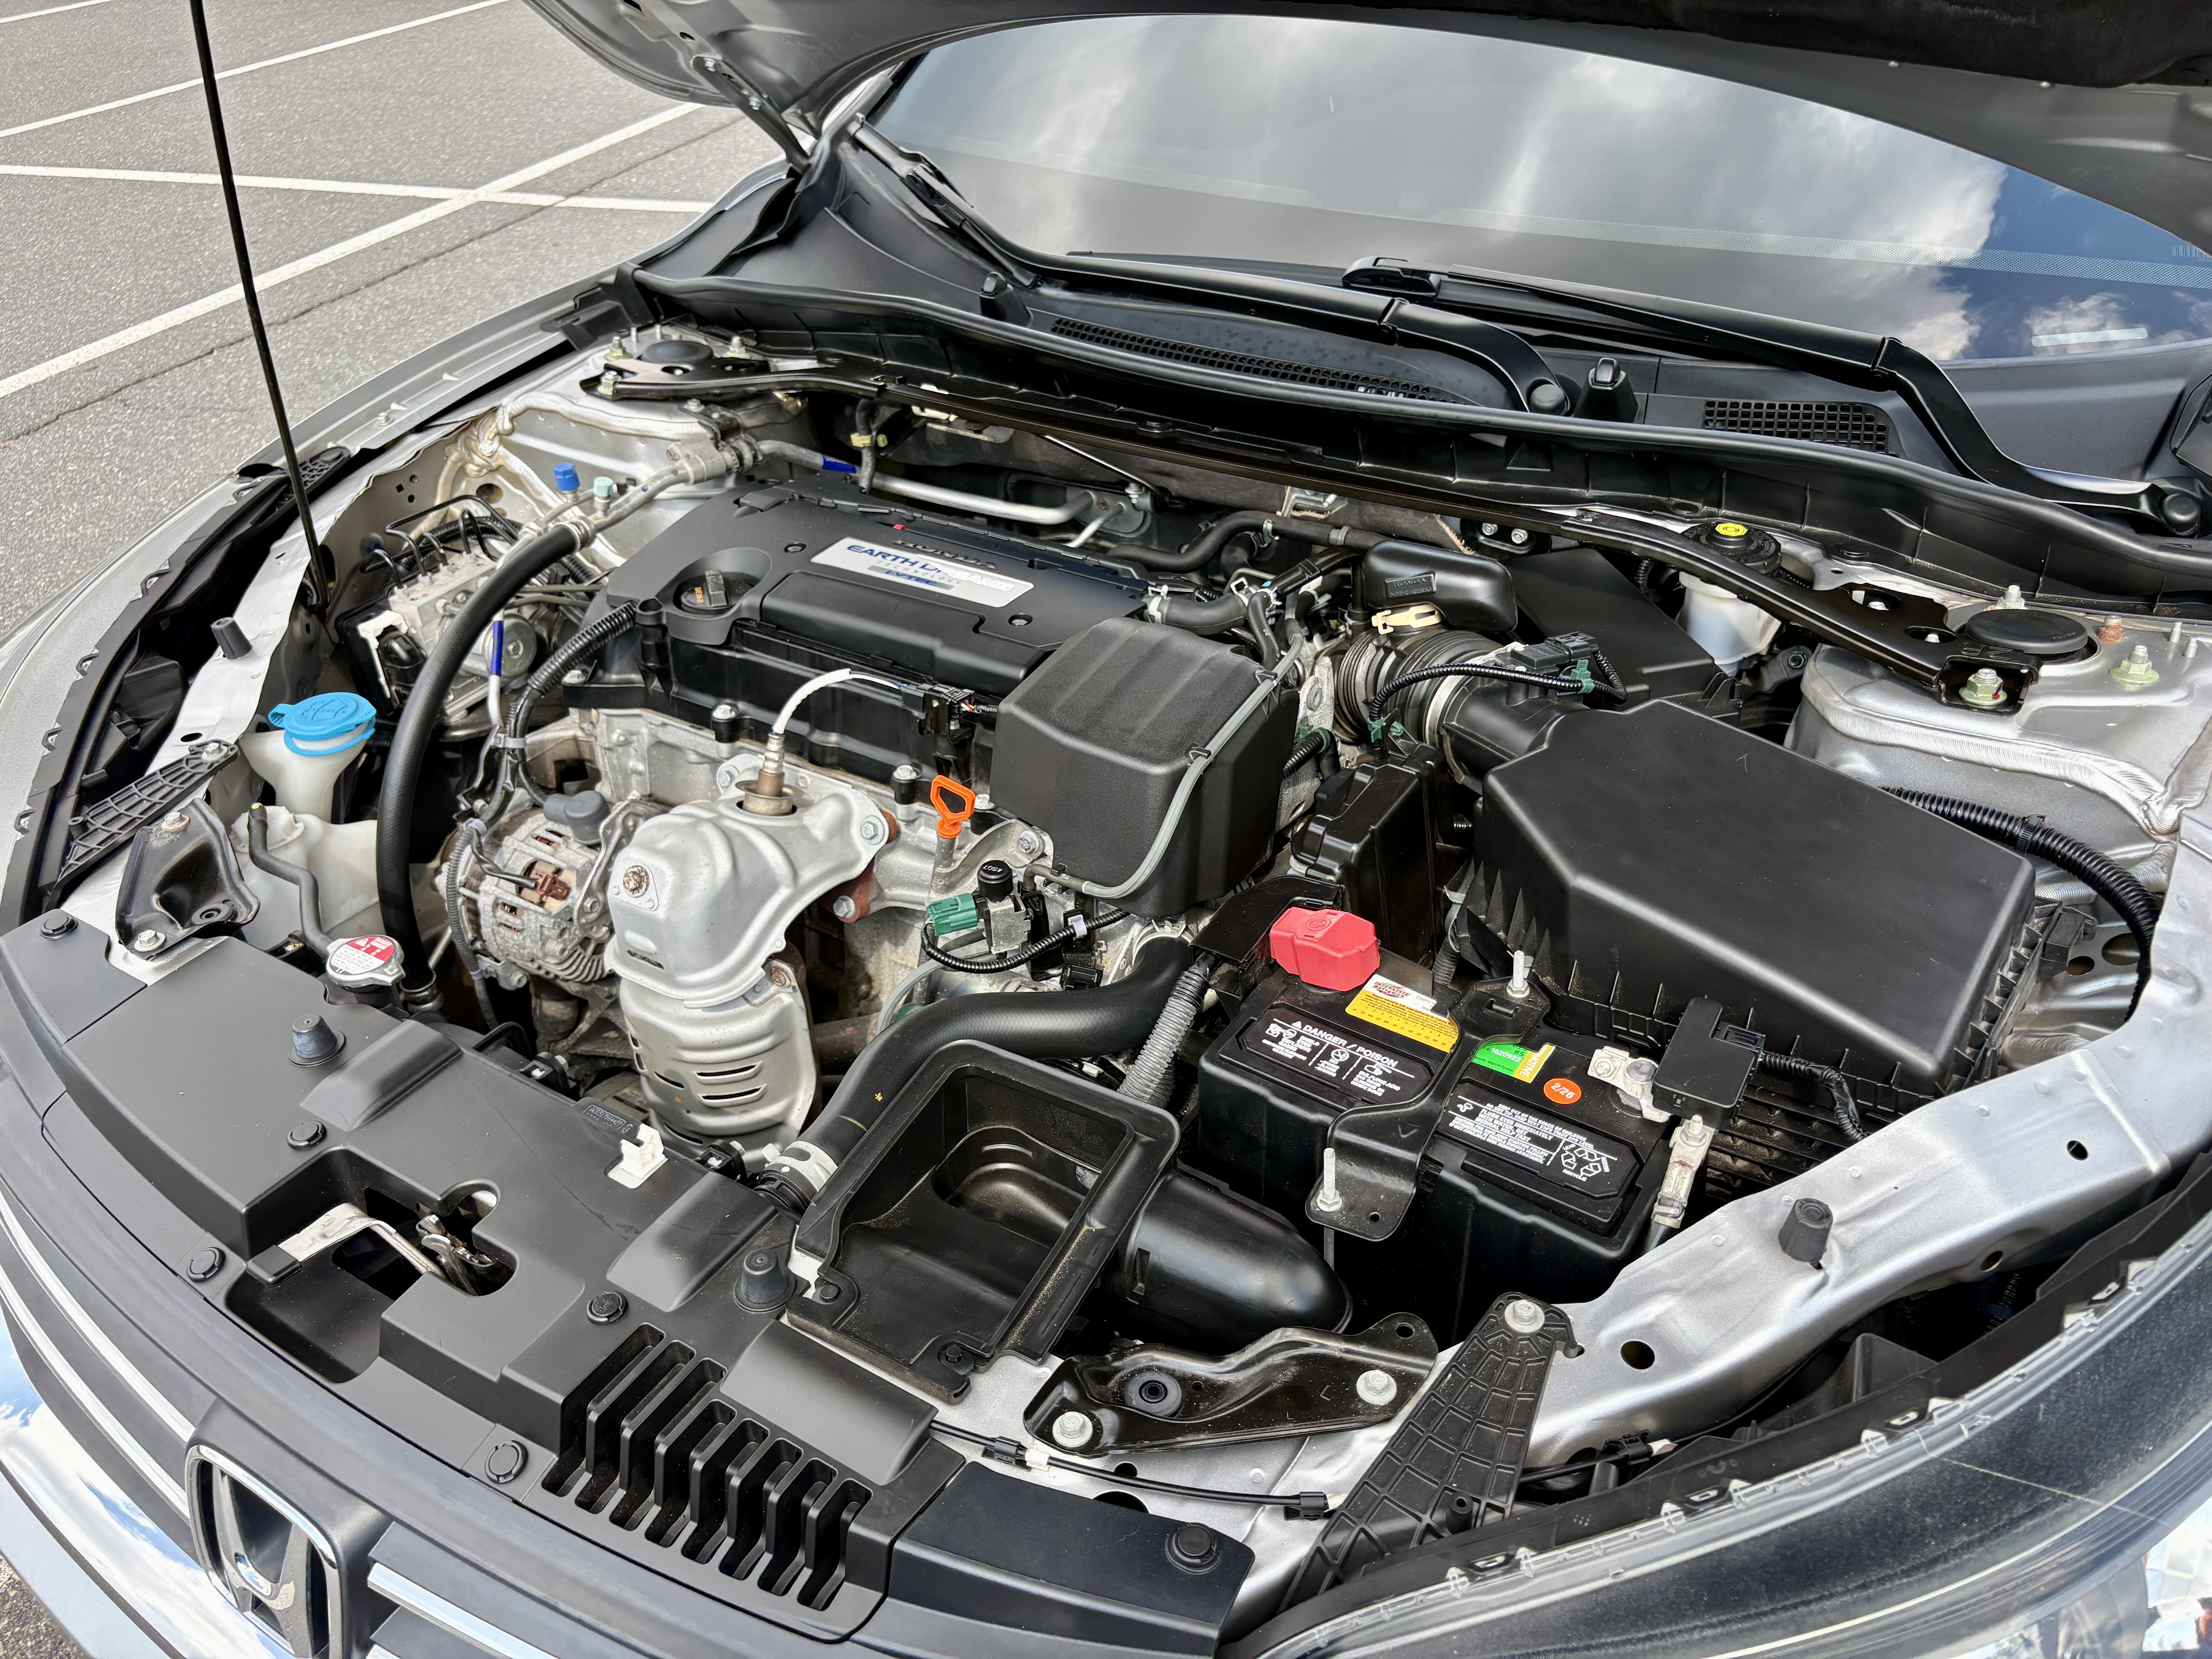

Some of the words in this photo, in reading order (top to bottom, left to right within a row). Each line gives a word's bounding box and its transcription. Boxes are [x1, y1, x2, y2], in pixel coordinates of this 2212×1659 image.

[847, 544, 919, 567] EARTH
[892, 540, 997, 570] HONDA
[877, 560, 962, 586] TECHNOLOGY
[1372, 985, 1407, 998] BATTERIES
[1374, 981, 1412, 997] INTERSTATE
[1416, 995, 1431, 1004] Costco
[1281, 1037, 1312, 1053] EXPLOSIVE
[1302, 1024, 1348, 1047] DANGER
[1355, 1046, 1398, 1067] POISON
[1491, 1048, 1522, 1062] 1620922
[1358, 1070, 1387, 1085] SULFURIC
[1386, 1083, 1401, 1091] ACID
[1550, 1082, 1575, 1099] 2/26
[1478, 1113, 1494, 1122] WITH
[1480, 1108, 1501, 1119] FLUSH
[1499, 1116, 1515, 1125] EYES
[1513, 1122, 1553, 1141] IMMEDIATELY
[1474, 1116, 1500, 1130] MEDICAL
[1500, 1128, 1516, 1136] HELP
[1515, 1133, 1531, 1142] FAST
[1539, 1120, 1555, 1129] REACH
[1562, 1129, 1587, 1142] CHILDREN
[1462, 1128, 1487, 1140] AVAILABLE
[1497, 1142, 1516, 1152] SERVICE
[1553, 1130, 1568, 1138] TIGHT
[1579, 1140, 1594, 1149] LEVEL
[1529, 1145, 1549, 1157] FOLLOW
[1562, 1169, 1587, 1182] RECYCLE
